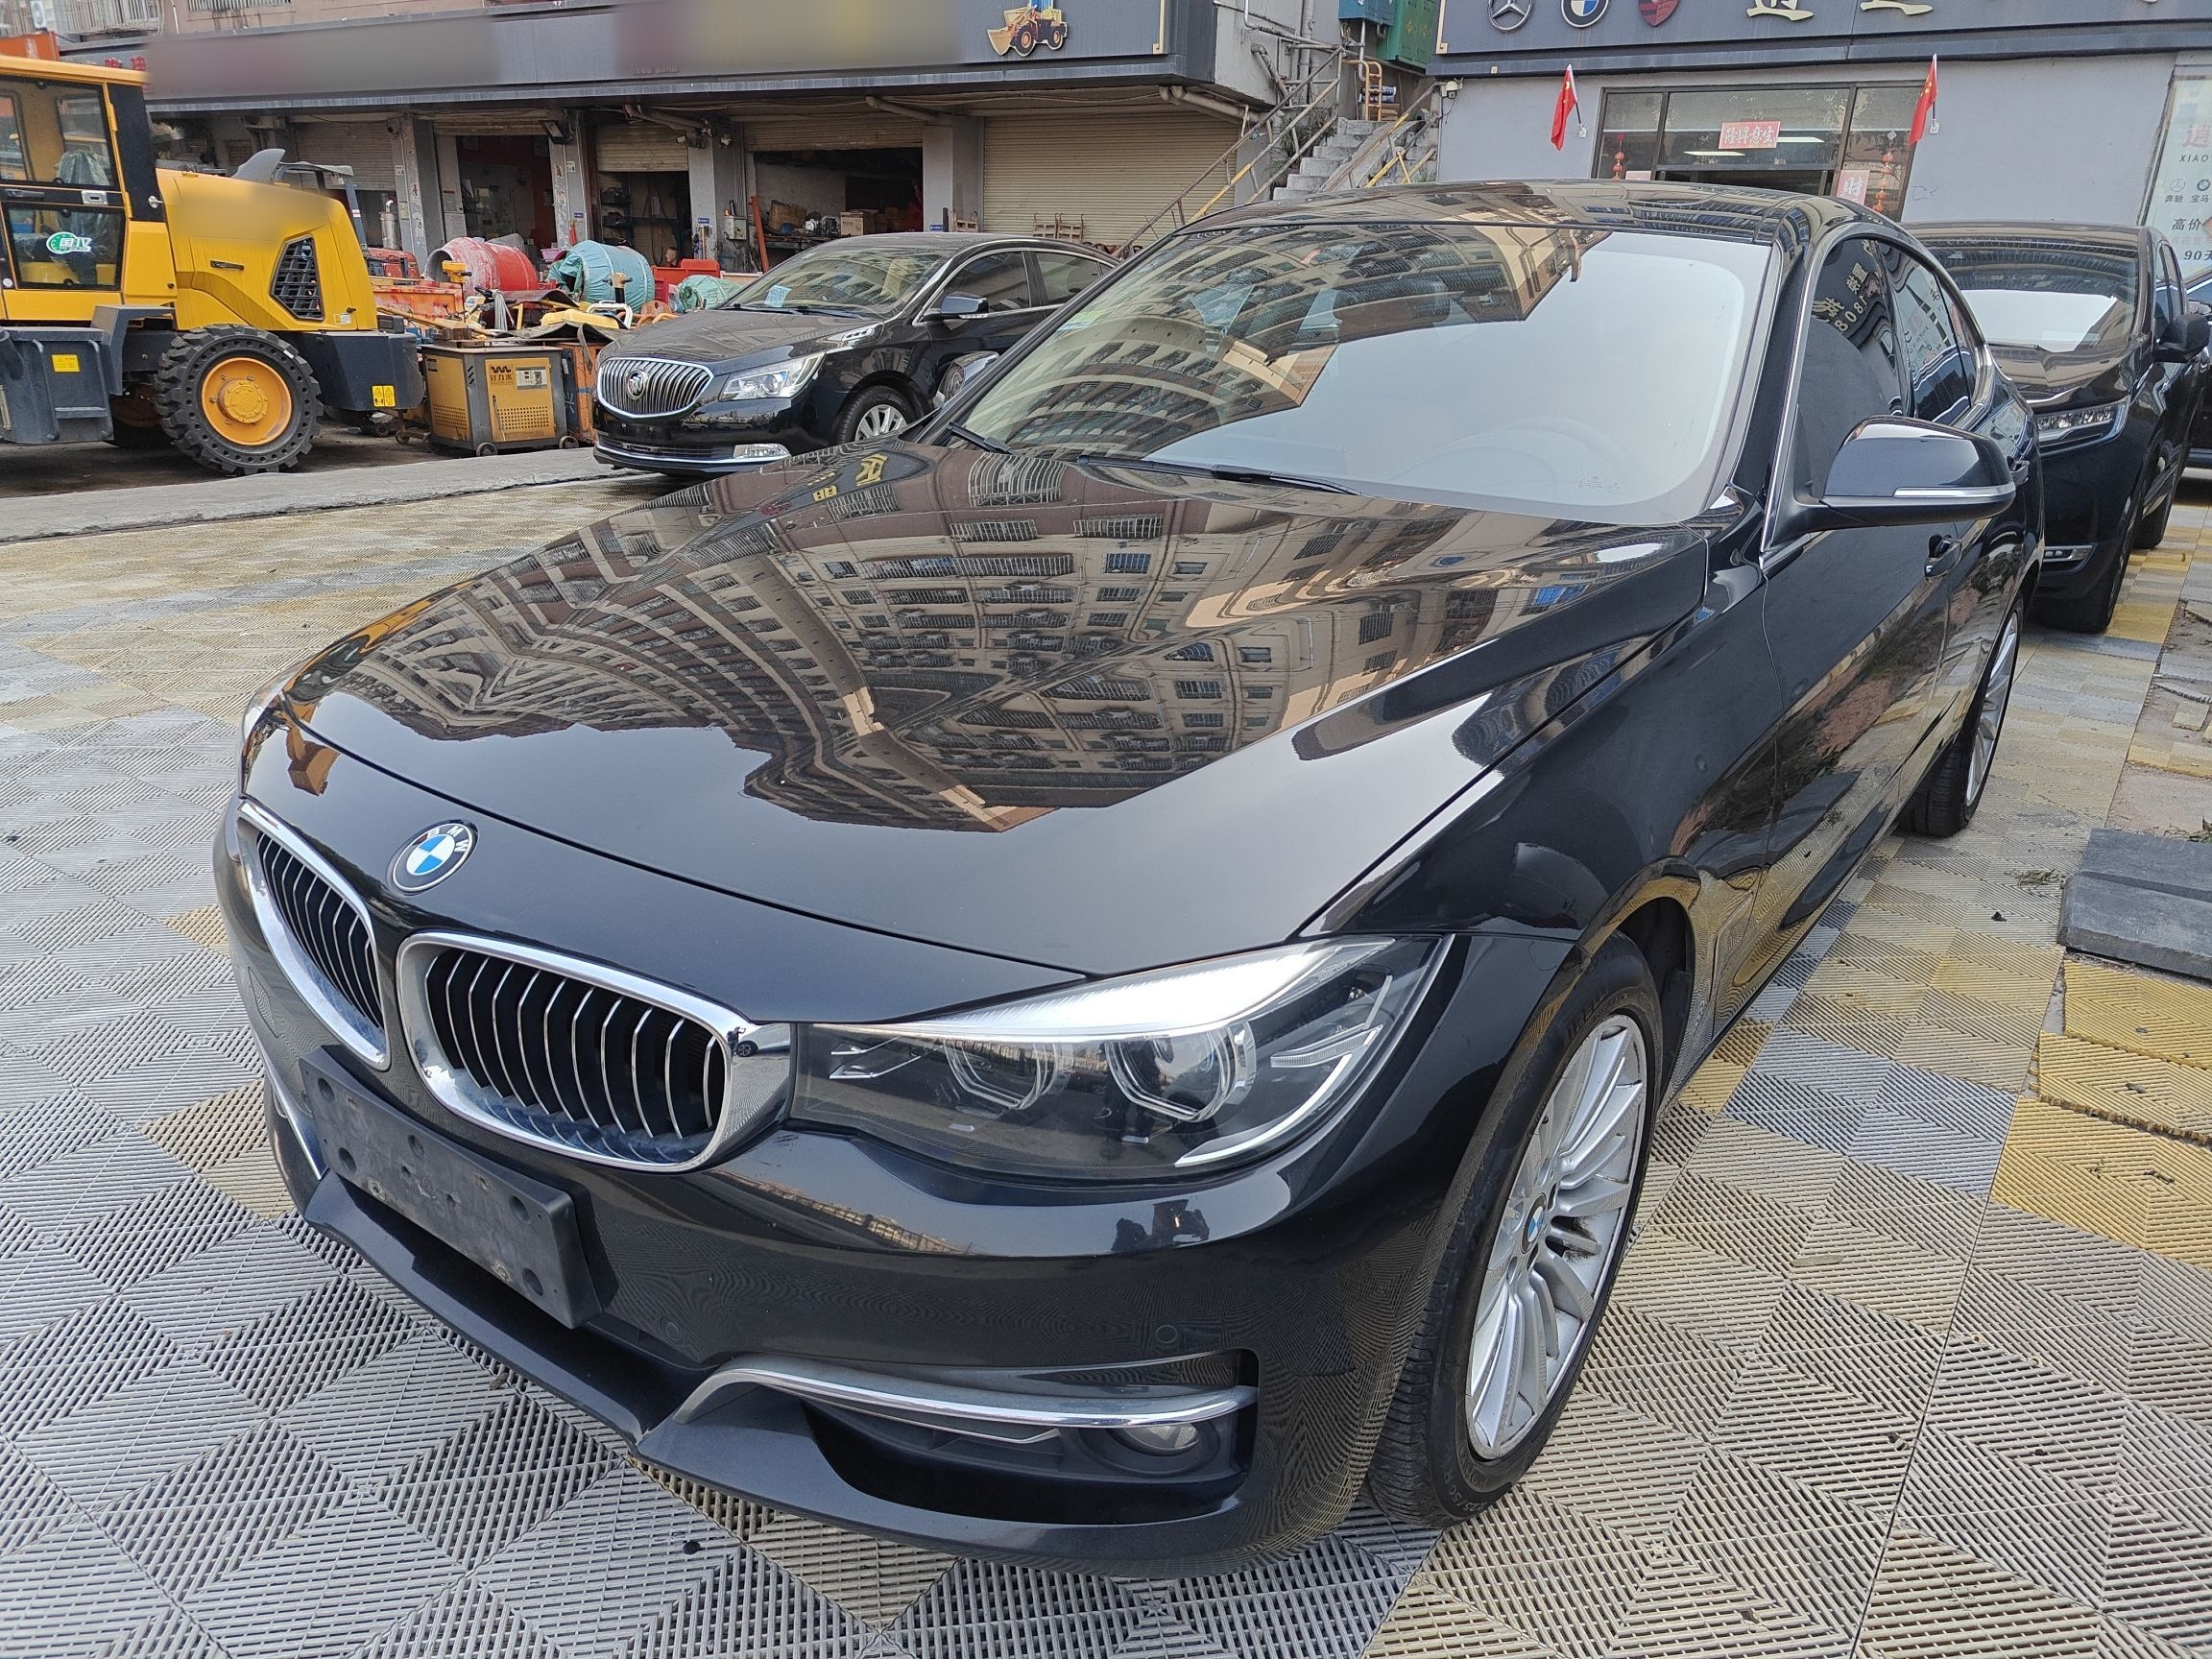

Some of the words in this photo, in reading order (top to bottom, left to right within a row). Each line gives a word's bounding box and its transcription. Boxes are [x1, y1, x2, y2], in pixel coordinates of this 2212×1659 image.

[2179, 154, 2209, 162] XIAO
[2190, 194, 2209, 204] 宝马
[2172, 218, 2201, 230] 高价
